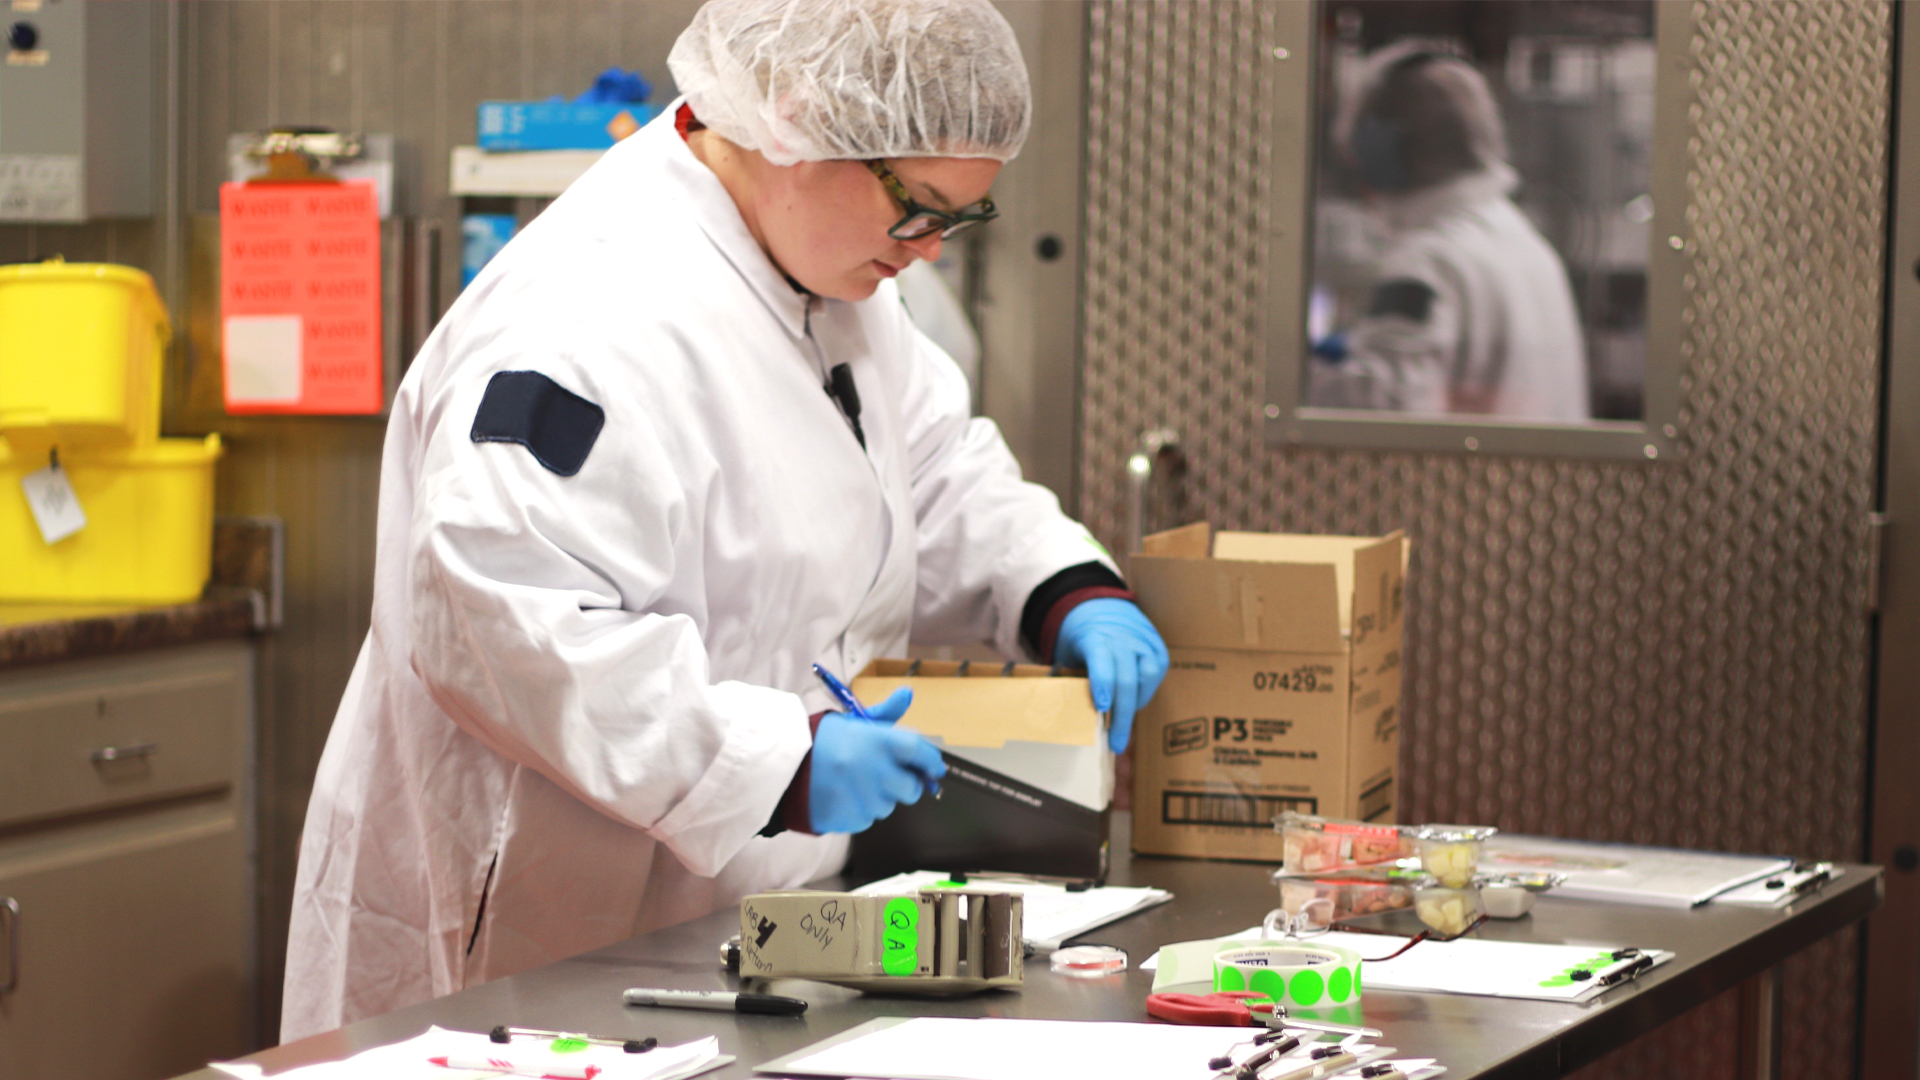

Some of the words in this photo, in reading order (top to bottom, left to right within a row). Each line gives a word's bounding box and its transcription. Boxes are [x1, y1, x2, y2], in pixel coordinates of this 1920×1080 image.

[1214, 717, 1248, 741] P3
[820, 900, 847, 932] QA
[888, 909, 911, 951] QA
